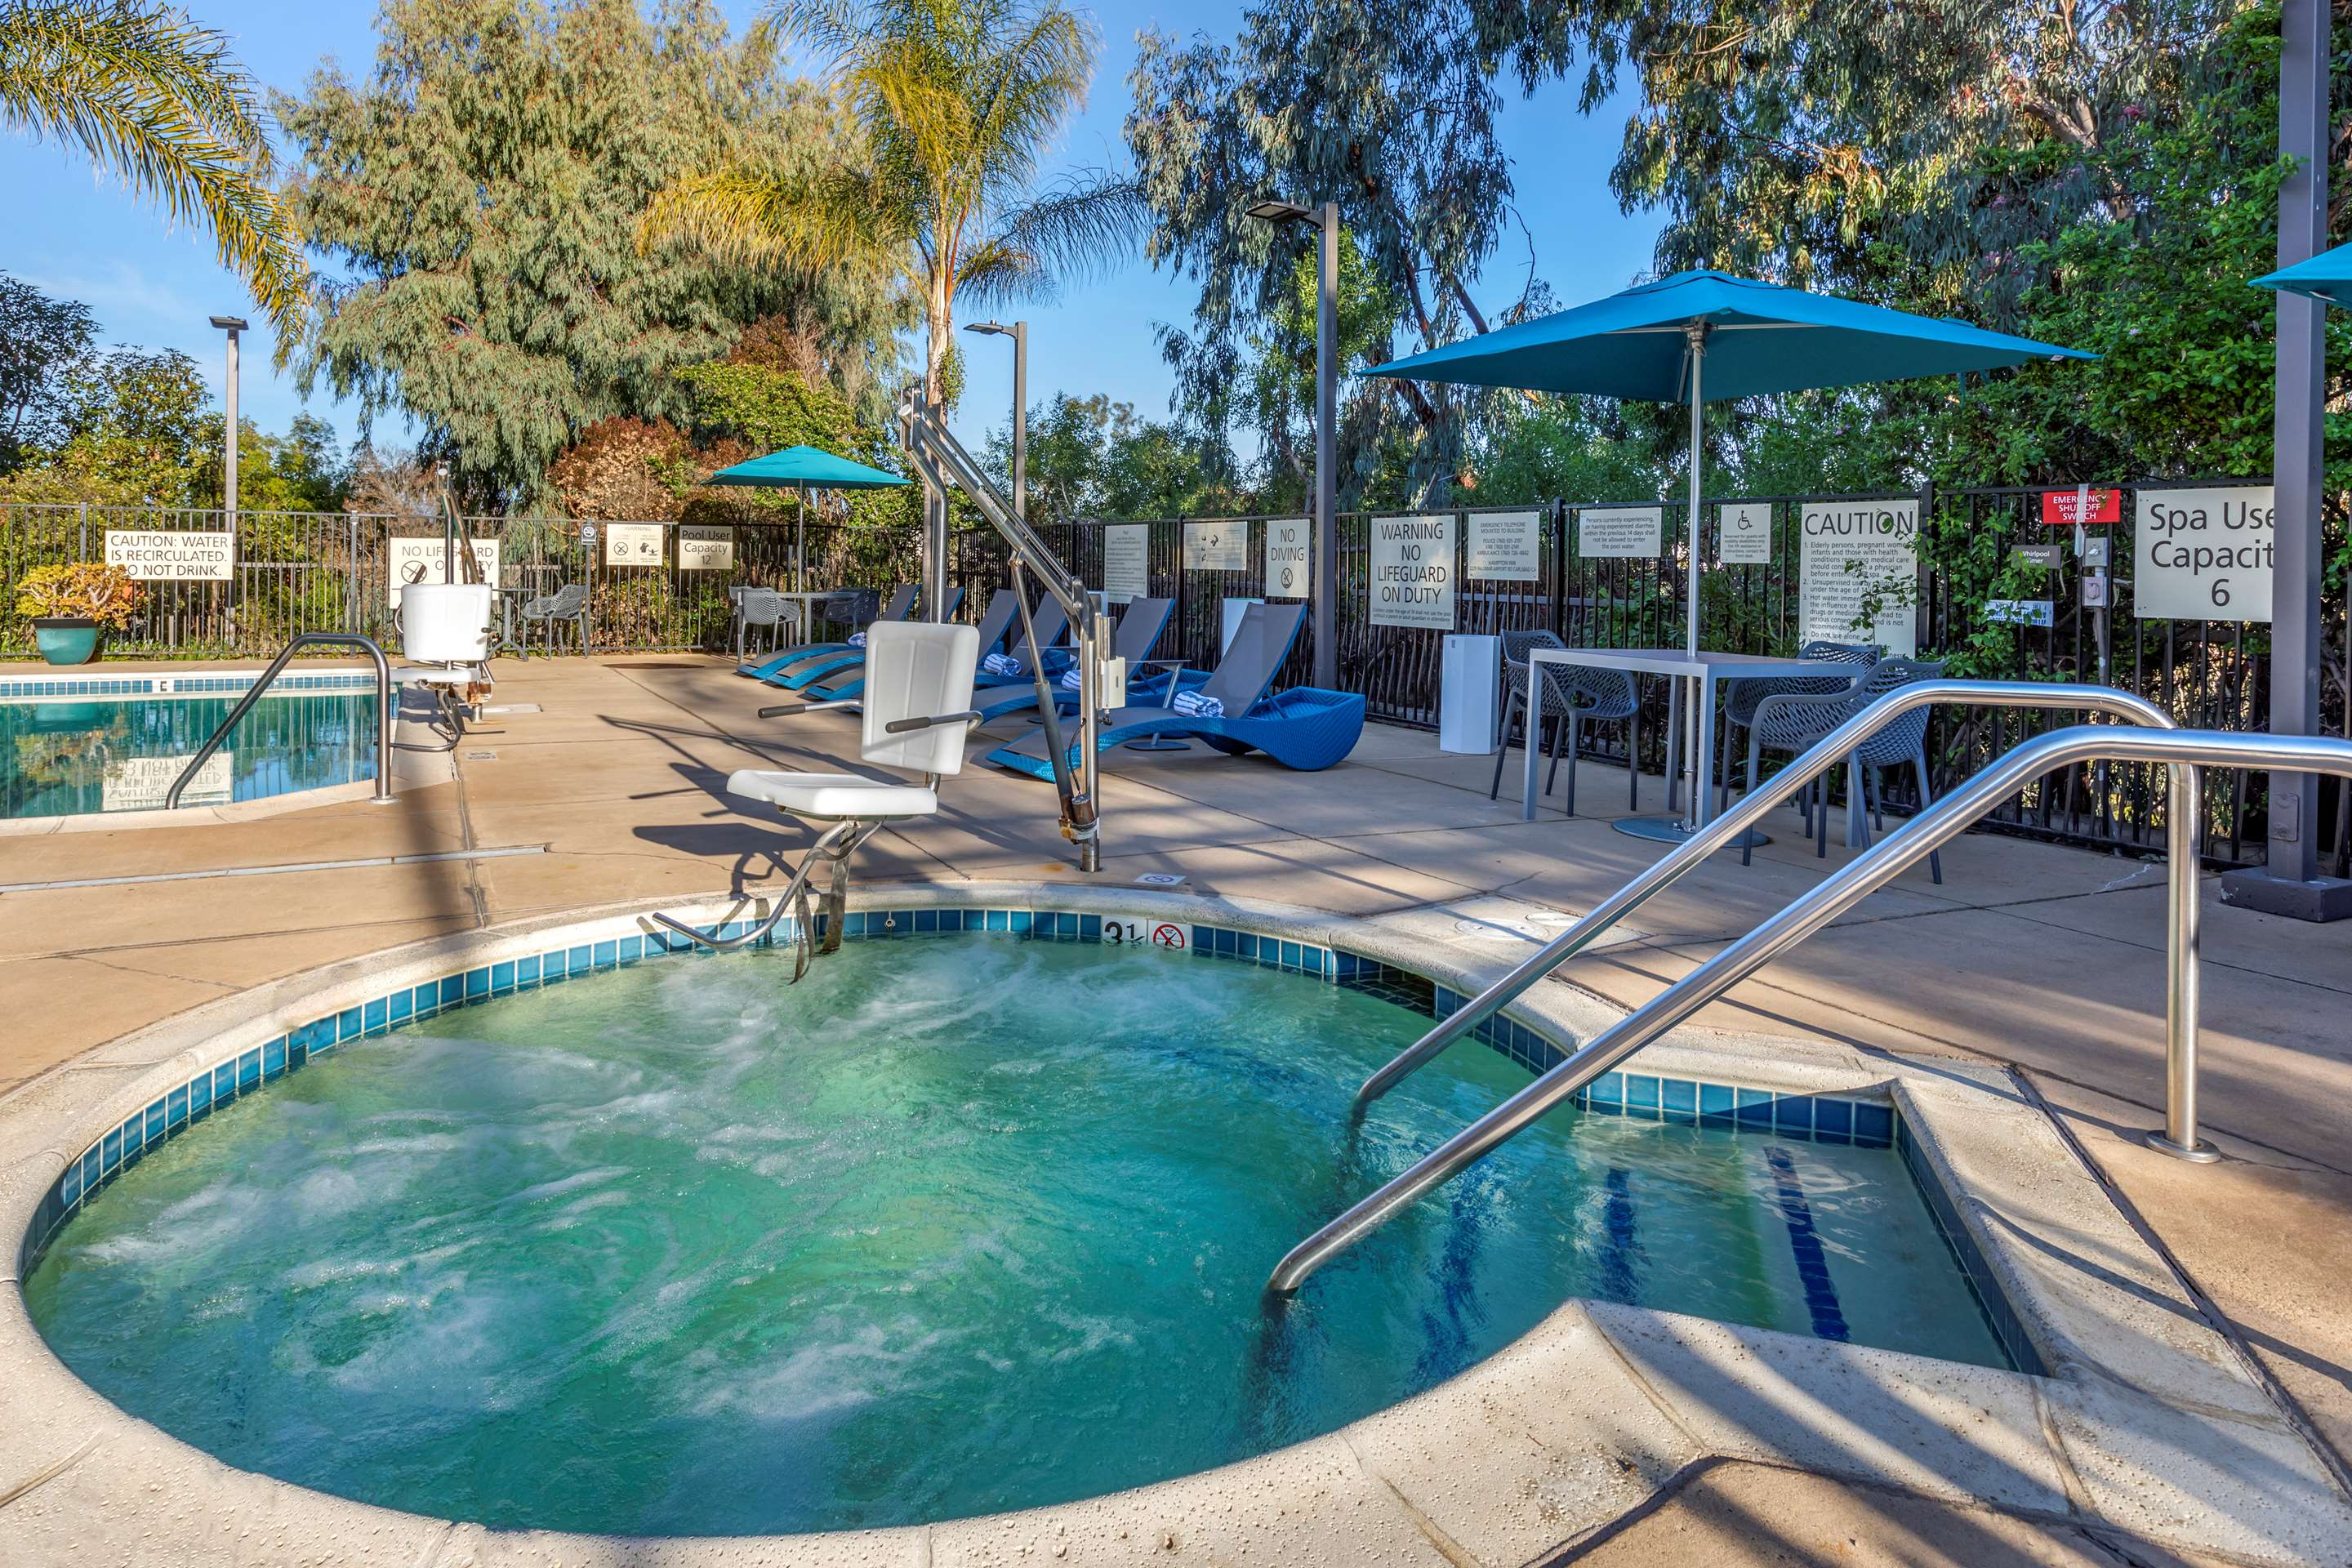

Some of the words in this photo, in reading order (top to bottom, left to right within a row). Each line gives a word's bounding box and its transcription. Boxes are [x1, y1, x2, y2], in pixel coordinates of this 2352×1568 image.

[2084, 503, 2100, 511] OFF
[1804, 510, 1913, 535] CAUTION
[2063, 512, 2096, 520] SWCH
[2150, 503, 2207, 538] Spa
[2223, 501, 2274, 530] Use
[682, 529, 705, 540] Pool
[708, 530, 731, 541] User
[1280, 528, 1295, 542] NO
[1380, 523, 1444, 541] WARNING
[110, 535, 177, 547] CAUTION:
[181, 536, 228, 548] WATER
[1811, 541, 1830, 550] Elderly
[1857, 542, 1885, 550] pregnant
[402, 546, 421, 556] NO
[684, 542, 728, 555] Capacity
[1271, 546, 1305, 561] DIVING
[1401, 544, 1421, 561] NO
[111, 550, 122, 561] IS
[127, 550, 227, 562] RECIRCULATED.
[702, 555, 711, 564] 12
[2151, 539, 2274, 576] Capacit
[144, 564, 172, 576] NOT
[177, 564, 222, 577] DRINK.
[1378, 565, 1446, 583] LIFEGUARD
[1382, 586, 1401, 603] ON
[1404, 586, 1441, 604] DUTY
[2211, 578, 2230, 607] 6
